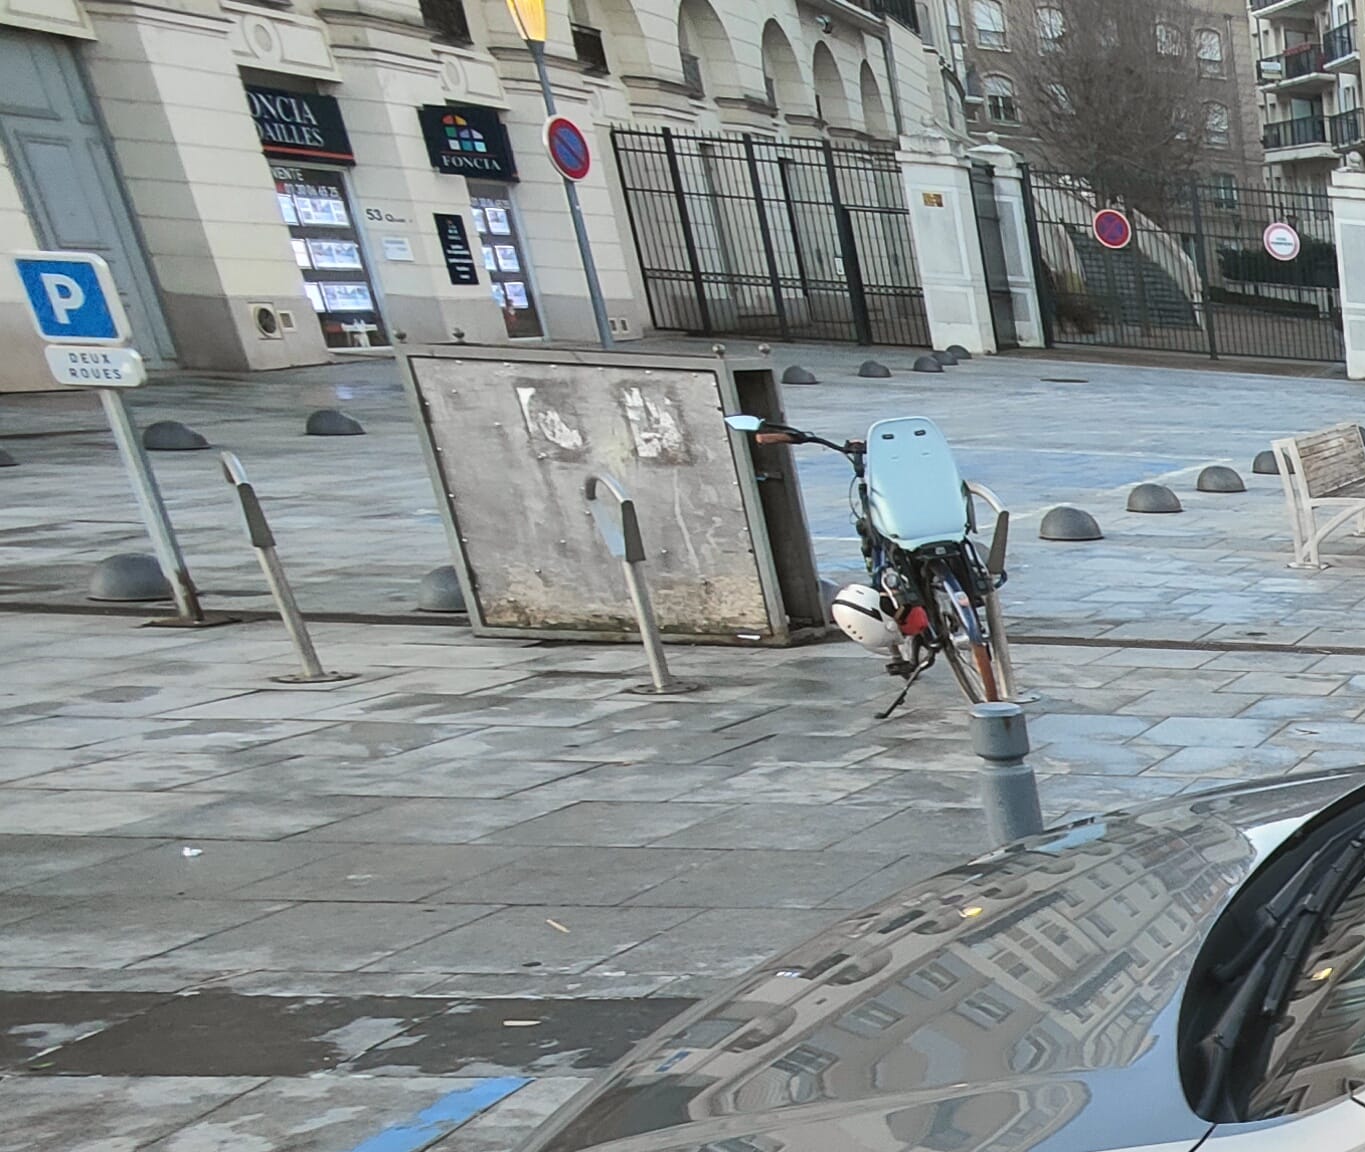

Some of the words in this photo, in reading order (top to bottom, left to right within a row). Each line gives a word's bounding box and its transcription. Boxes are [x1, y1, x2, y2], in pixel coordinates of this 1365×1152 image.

[442, 155, 501, 171] FONCIA
[366, 208, 383, 221] 53
[40, 272, 86, 324] P
[68, 352, 111, 364] DEUX
[68, 367, 122, 380] ROUES
